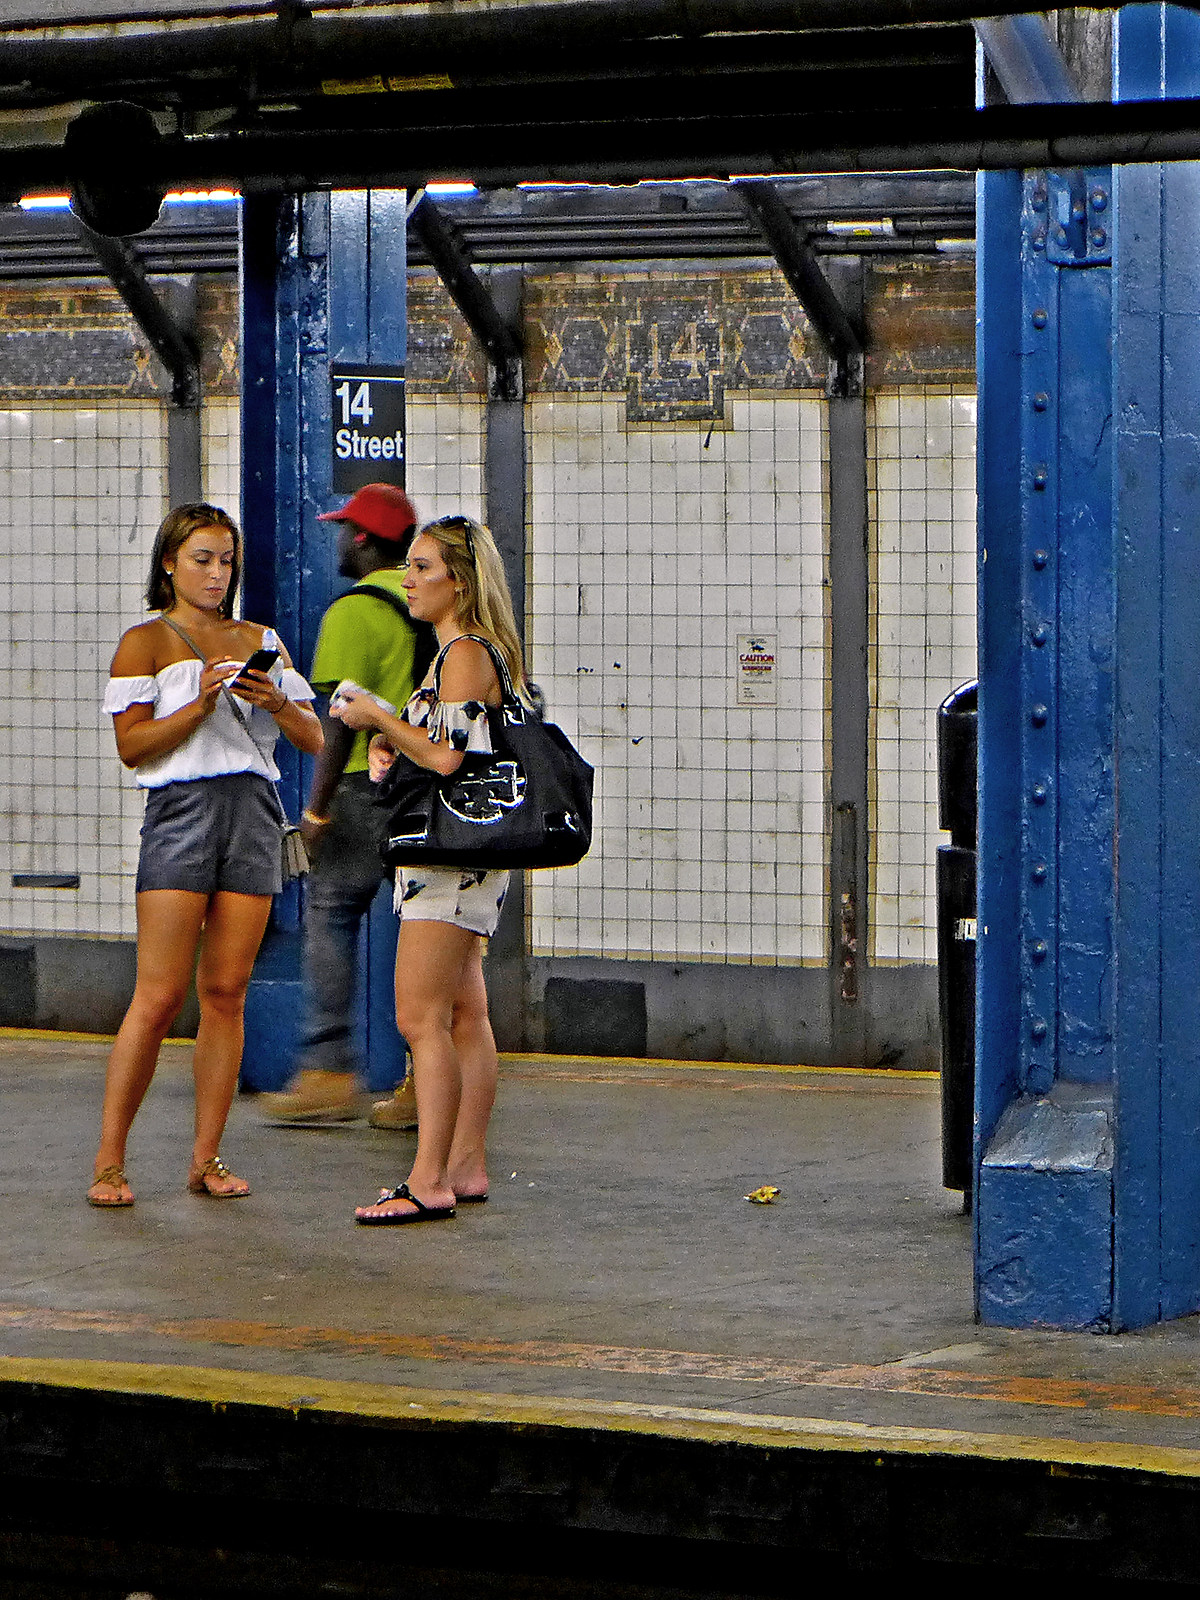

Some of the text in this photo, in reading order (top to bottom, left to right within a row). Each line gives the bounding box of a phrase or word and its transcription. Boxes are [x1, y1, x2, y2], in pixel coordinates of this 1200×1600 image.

[648, 322, 706, 380] 14
[335, 382, 374, 426] 14
[335, 428, 404, 460] Street
[739, 653, 775, 662] CAUTION
